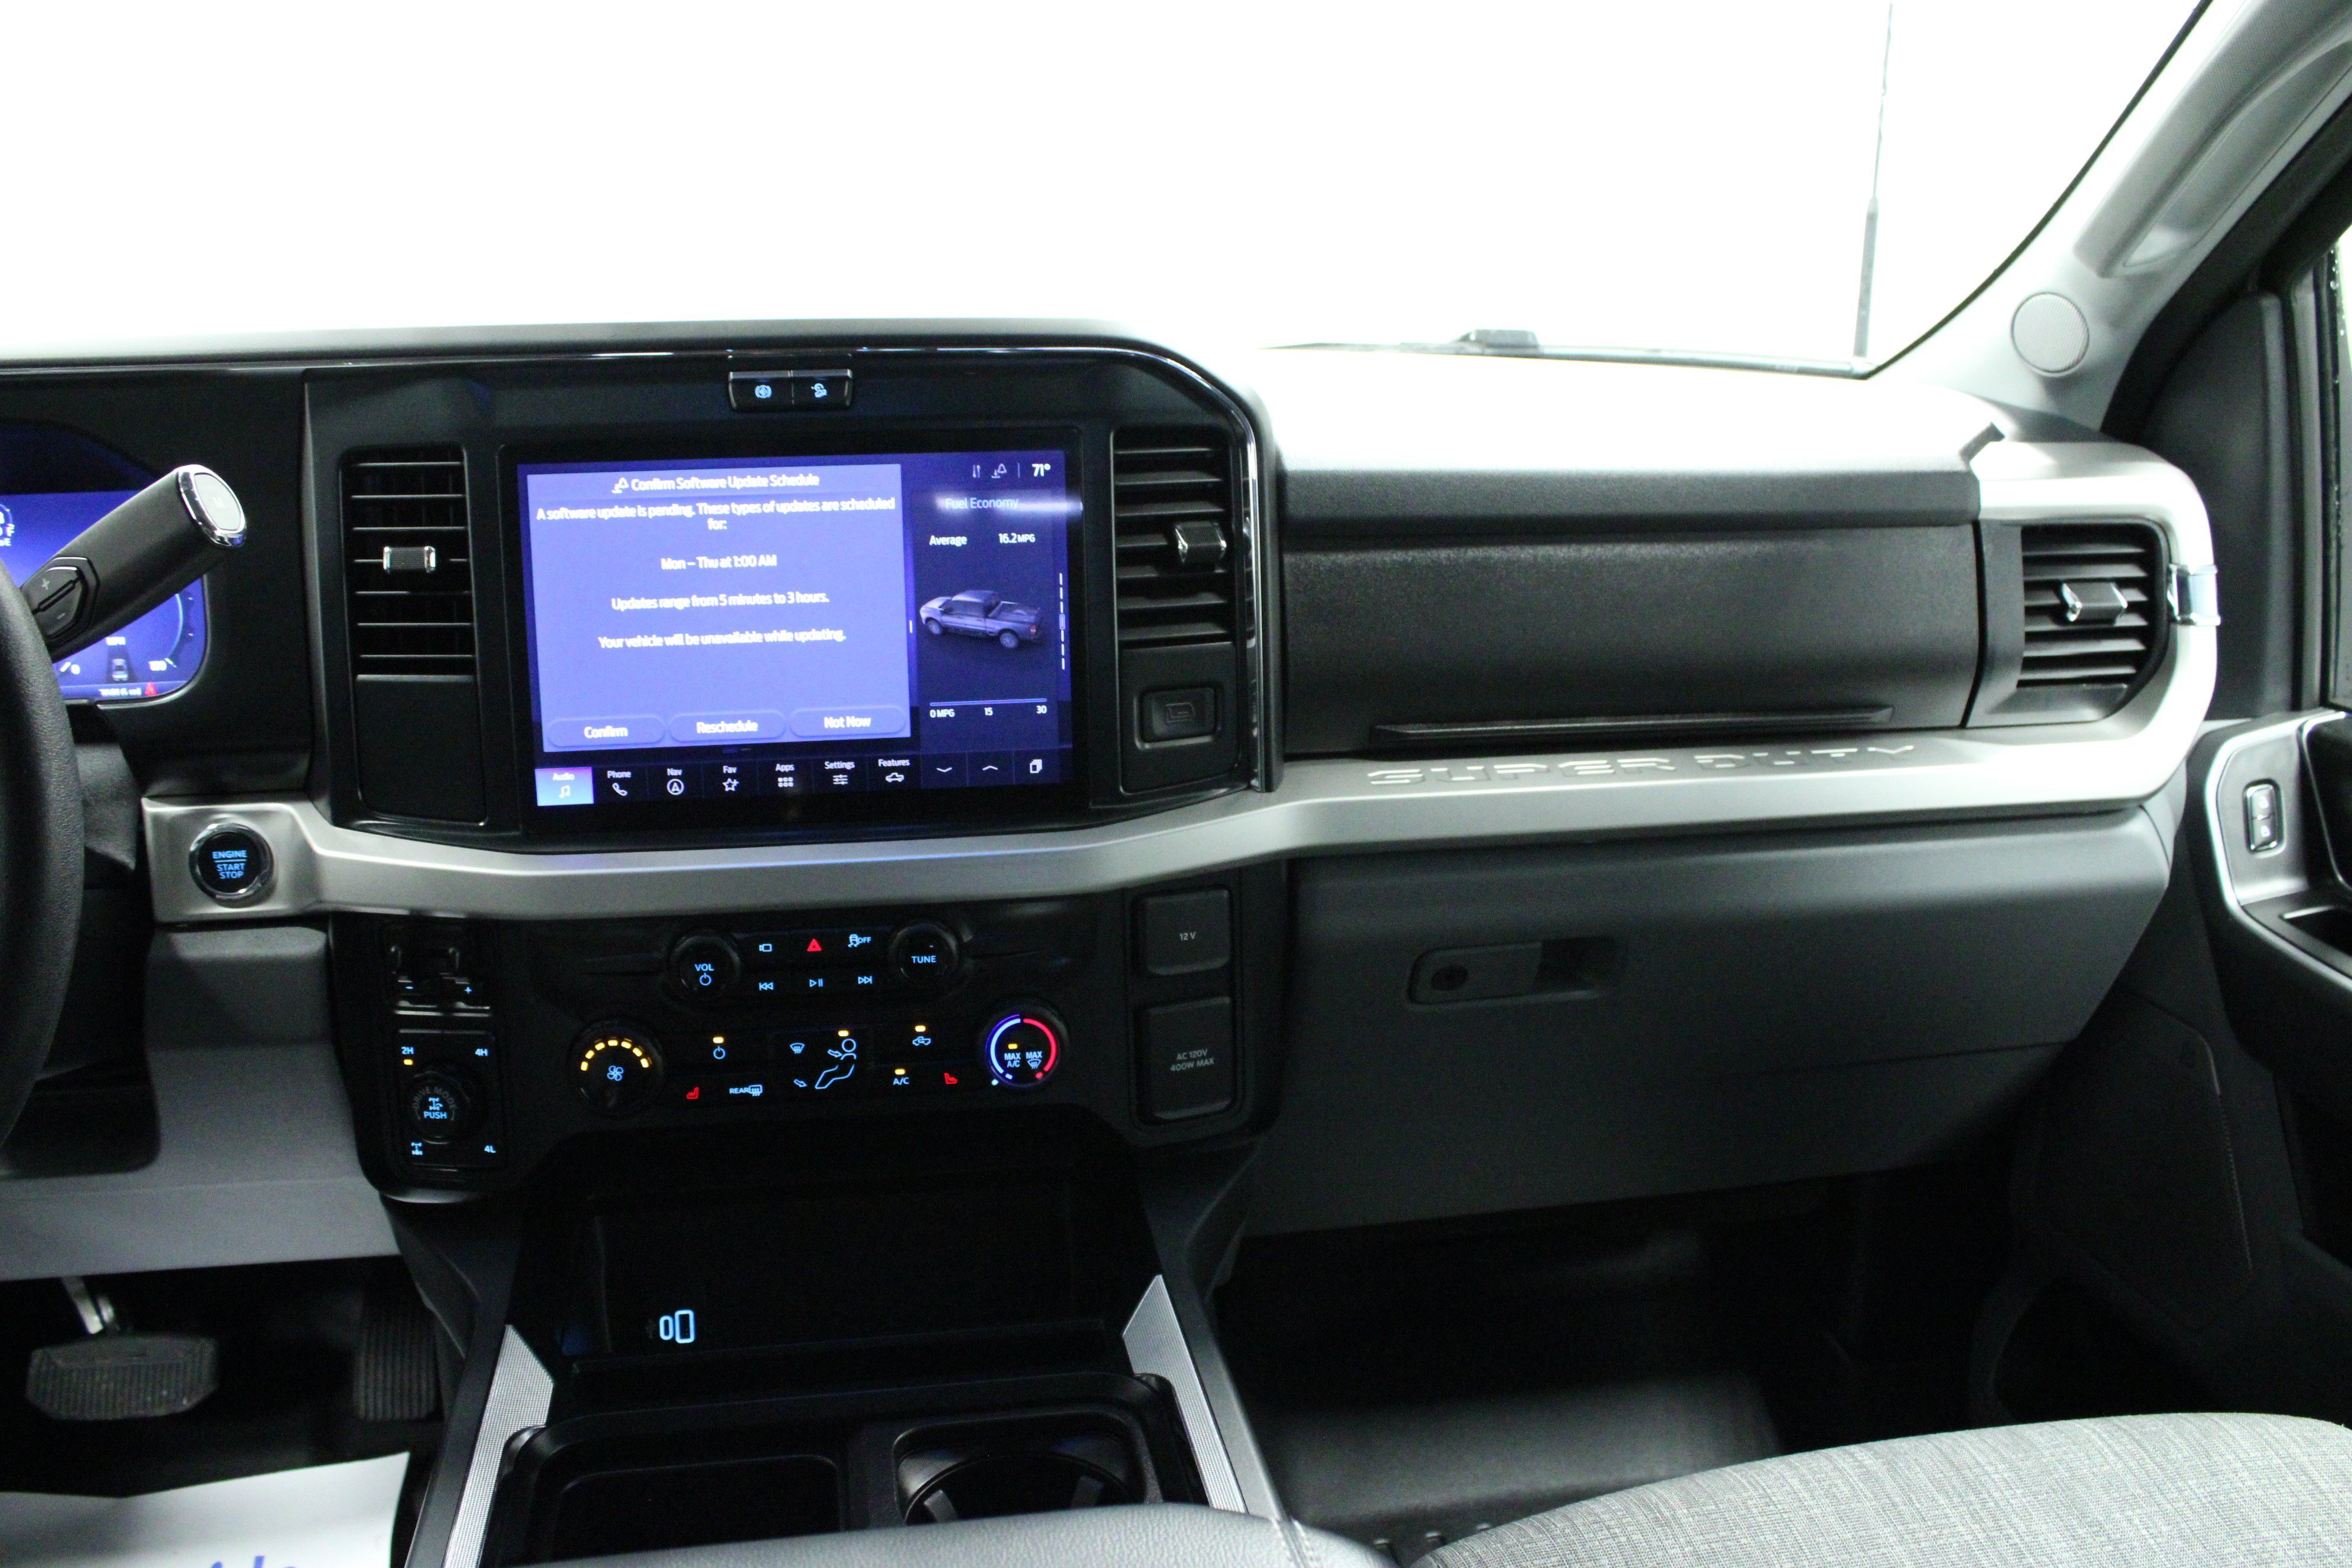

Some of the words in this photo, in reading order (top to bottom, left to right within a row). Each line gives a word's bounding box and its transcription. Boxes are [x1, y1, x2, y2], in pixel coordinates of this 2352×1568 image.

[631, 478, 675, 491] Confirm
[676, 476, 727, 489] Software
[727, 475, 769, 490] Update
[769, 473, 820, 486] Schedule
[945, 498, 968, 509] Fuel
[970, 497, 1019, 509] Economy
[536, 508, 546, 520] A
[547, 507, 596, 520] software
[597, 505, 636, 520] update
[637, 505, 647, 518] is
[648, 504, 695, 518] pending.
[696, 502, 730, 515] These
[730, 502, 762, 516] types
[762, 500, 776, 513] of
[776, 499, 821, 514] updates
[821, 501, 839, 512] are
[840, 496, 896, 511] scheduled
[707, 517, 727, 530] for:
[929, 534, 968, 547] Average
[661, 557, 686, 570] Mon
[695, 556, 718, 569] Thu
[719, 556, 732, 568] at
[733, 555, 757, 567] 1:00
[757, 554, 777, 567] AM
[611, 597, 658, 612] Updates
[659, 597, 690, 610] range
[691, 594, 718, 607] from
[719, 593, 727, 606] 5
[728, 593, 773, 606] minutes
[773, 592, 786, 605] to
[786, 591, 795, 604] 3
[795, 591, 829, 603] hours.
[597, 636, 624, 648] Your
[625, 634, 664, 648] vehicle
[664, 633, 684, 646] will
[685, 633, 700, 645] be
[700, 631, 763, 645] unavailable
[763, 629, 793, 642] while
[794, 628, 847, 643] updating.
[937, 708, 955, 718] MPG
[984, 707, 993, 716] 15
[1036, 705, 1047, 714] 30
[696, 720, 758, 734] Reschedule
[824, 717, 844, 729] Not
[845, 716, 871, 727] Now
[583, 725, 629, 739] Confirm
[824, 760, 855, 770] Settings
[878, 758, 910, 767] Features
[1366, 757, 1678, 786] SUPER
[1693, 744, 1916, 771] DUTY
[667, 767, 683, 776] Nav
[722, 765, 737, 774] Fav
[775, 763, 795, 772] Apps
[552, 772, 575, 781] Audio
[607, 770, 632, 779] Phone
[212, 850, 248, 859] ENGINE
[216, 863, 246, 872] START
[219, 871, 244, 879] STOP
[912, 955, 937, 963] TUNE
[694, 963, 714, 972] VOL
[401, 1046, 414, 1056] 2H
[475, 1048, 489, 1057] 4H
[1025, 1050, 1043, 1060] MAX
[1189, 1048, 1208, 1059] 120V
[1004, 1052, 1021, 1061] MAX
[1007, 1060, 1021, 1069] A/C
[1170, 1061, 1194, 1072] 400W
[1196, 1057, 1214, 1067] MAX
[893, 1077, 910, 1086] A/C
[423, 1110, 448, 1119] PUSH
[484, 1145, 496, 1154] 4L
